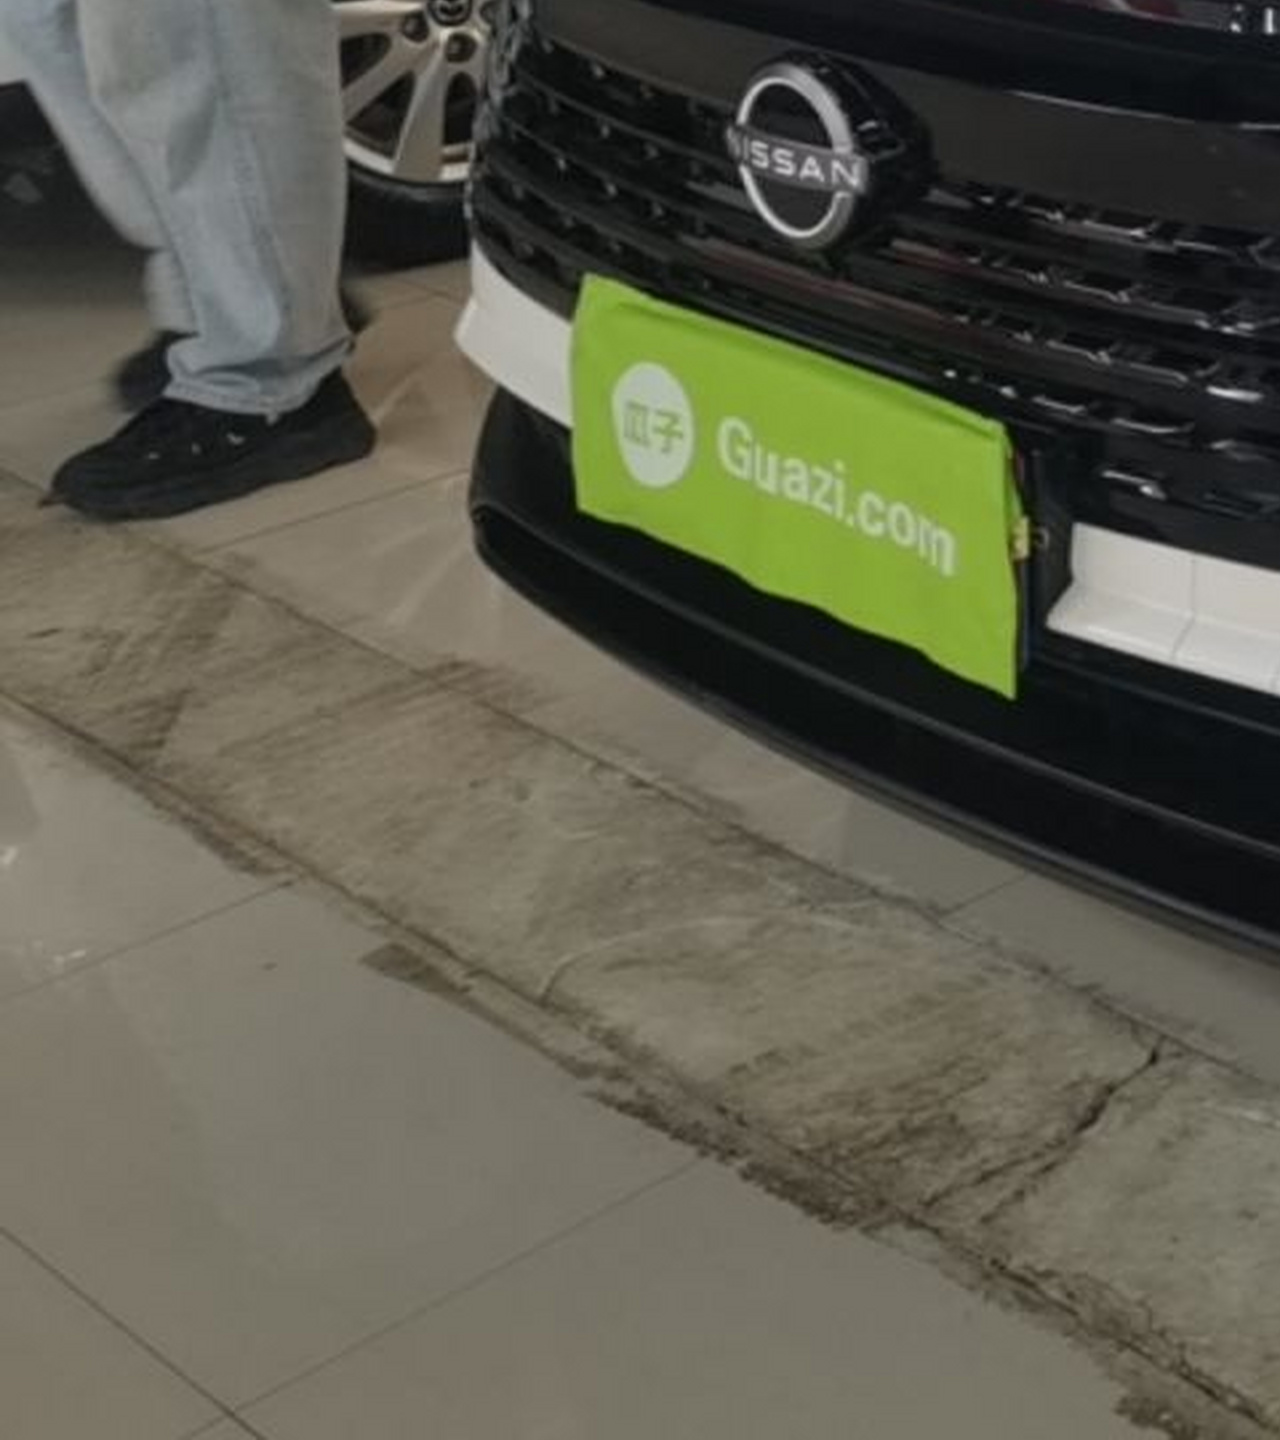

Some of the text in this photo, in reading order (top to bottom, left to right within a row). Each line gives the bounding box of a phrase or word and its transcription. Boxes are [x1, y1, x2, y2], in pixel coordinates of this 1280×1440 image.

[726, 126, 866, 190] NISSAN
[622, 400, 686, 455] 瓜子
[716, 415, 958, 578] Guazi.com
